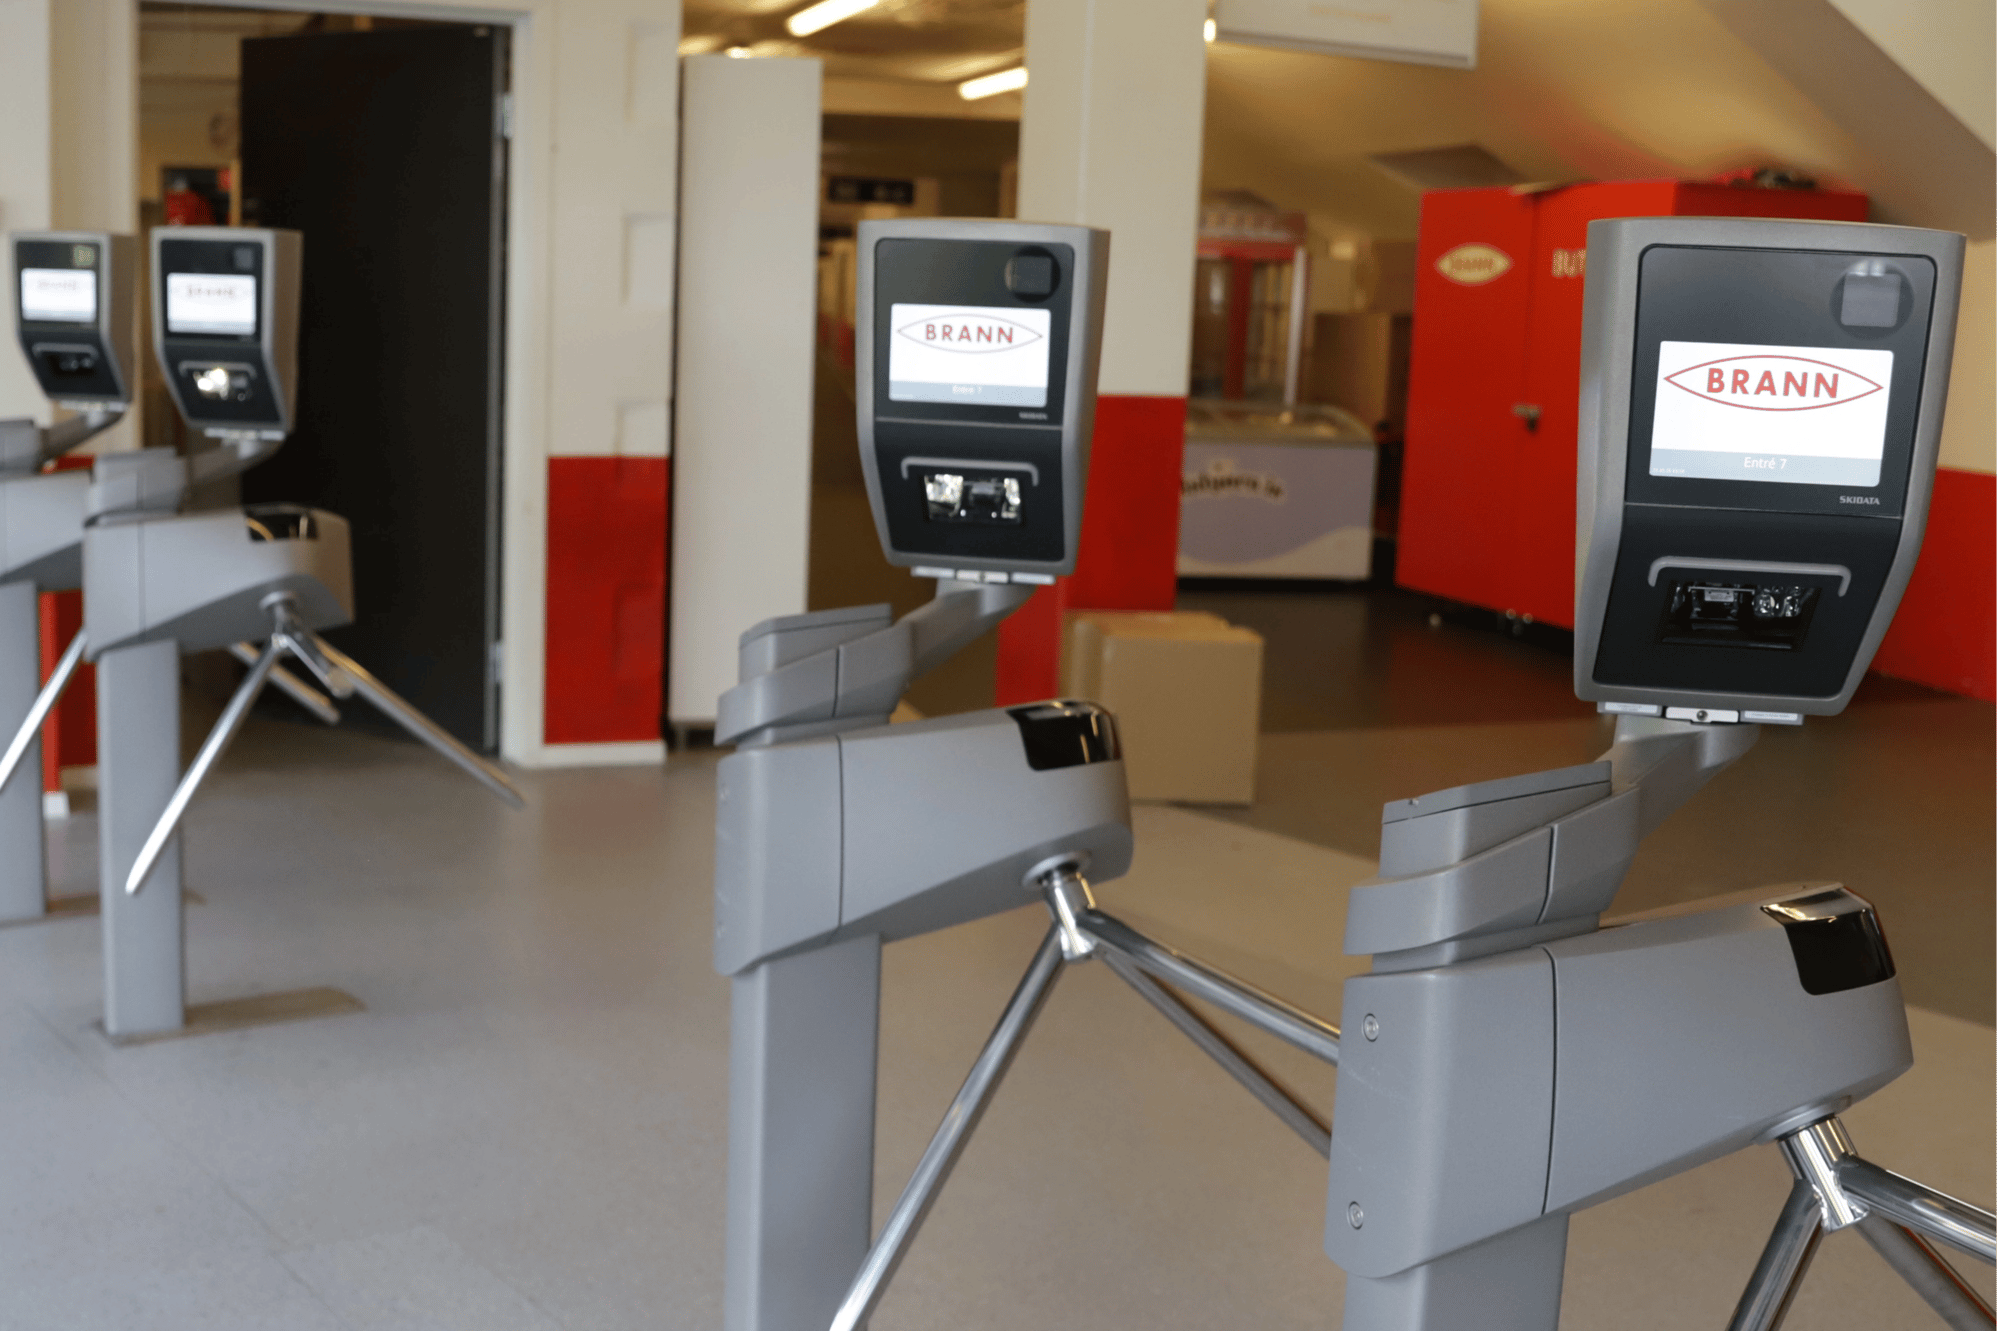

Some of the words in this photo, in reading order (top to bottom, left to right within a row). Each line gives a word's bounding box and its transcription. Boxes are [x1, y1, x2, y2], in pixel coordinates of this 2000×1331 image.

[926, 324, 1013, 343] BRANN
[1707, 368, 1839, 398] BRANN
[1743, 456, 1776, 470] Entré
[1779, 458, 1788, 470] 7
[1839, 495, 1880, 505] SKIDATA
